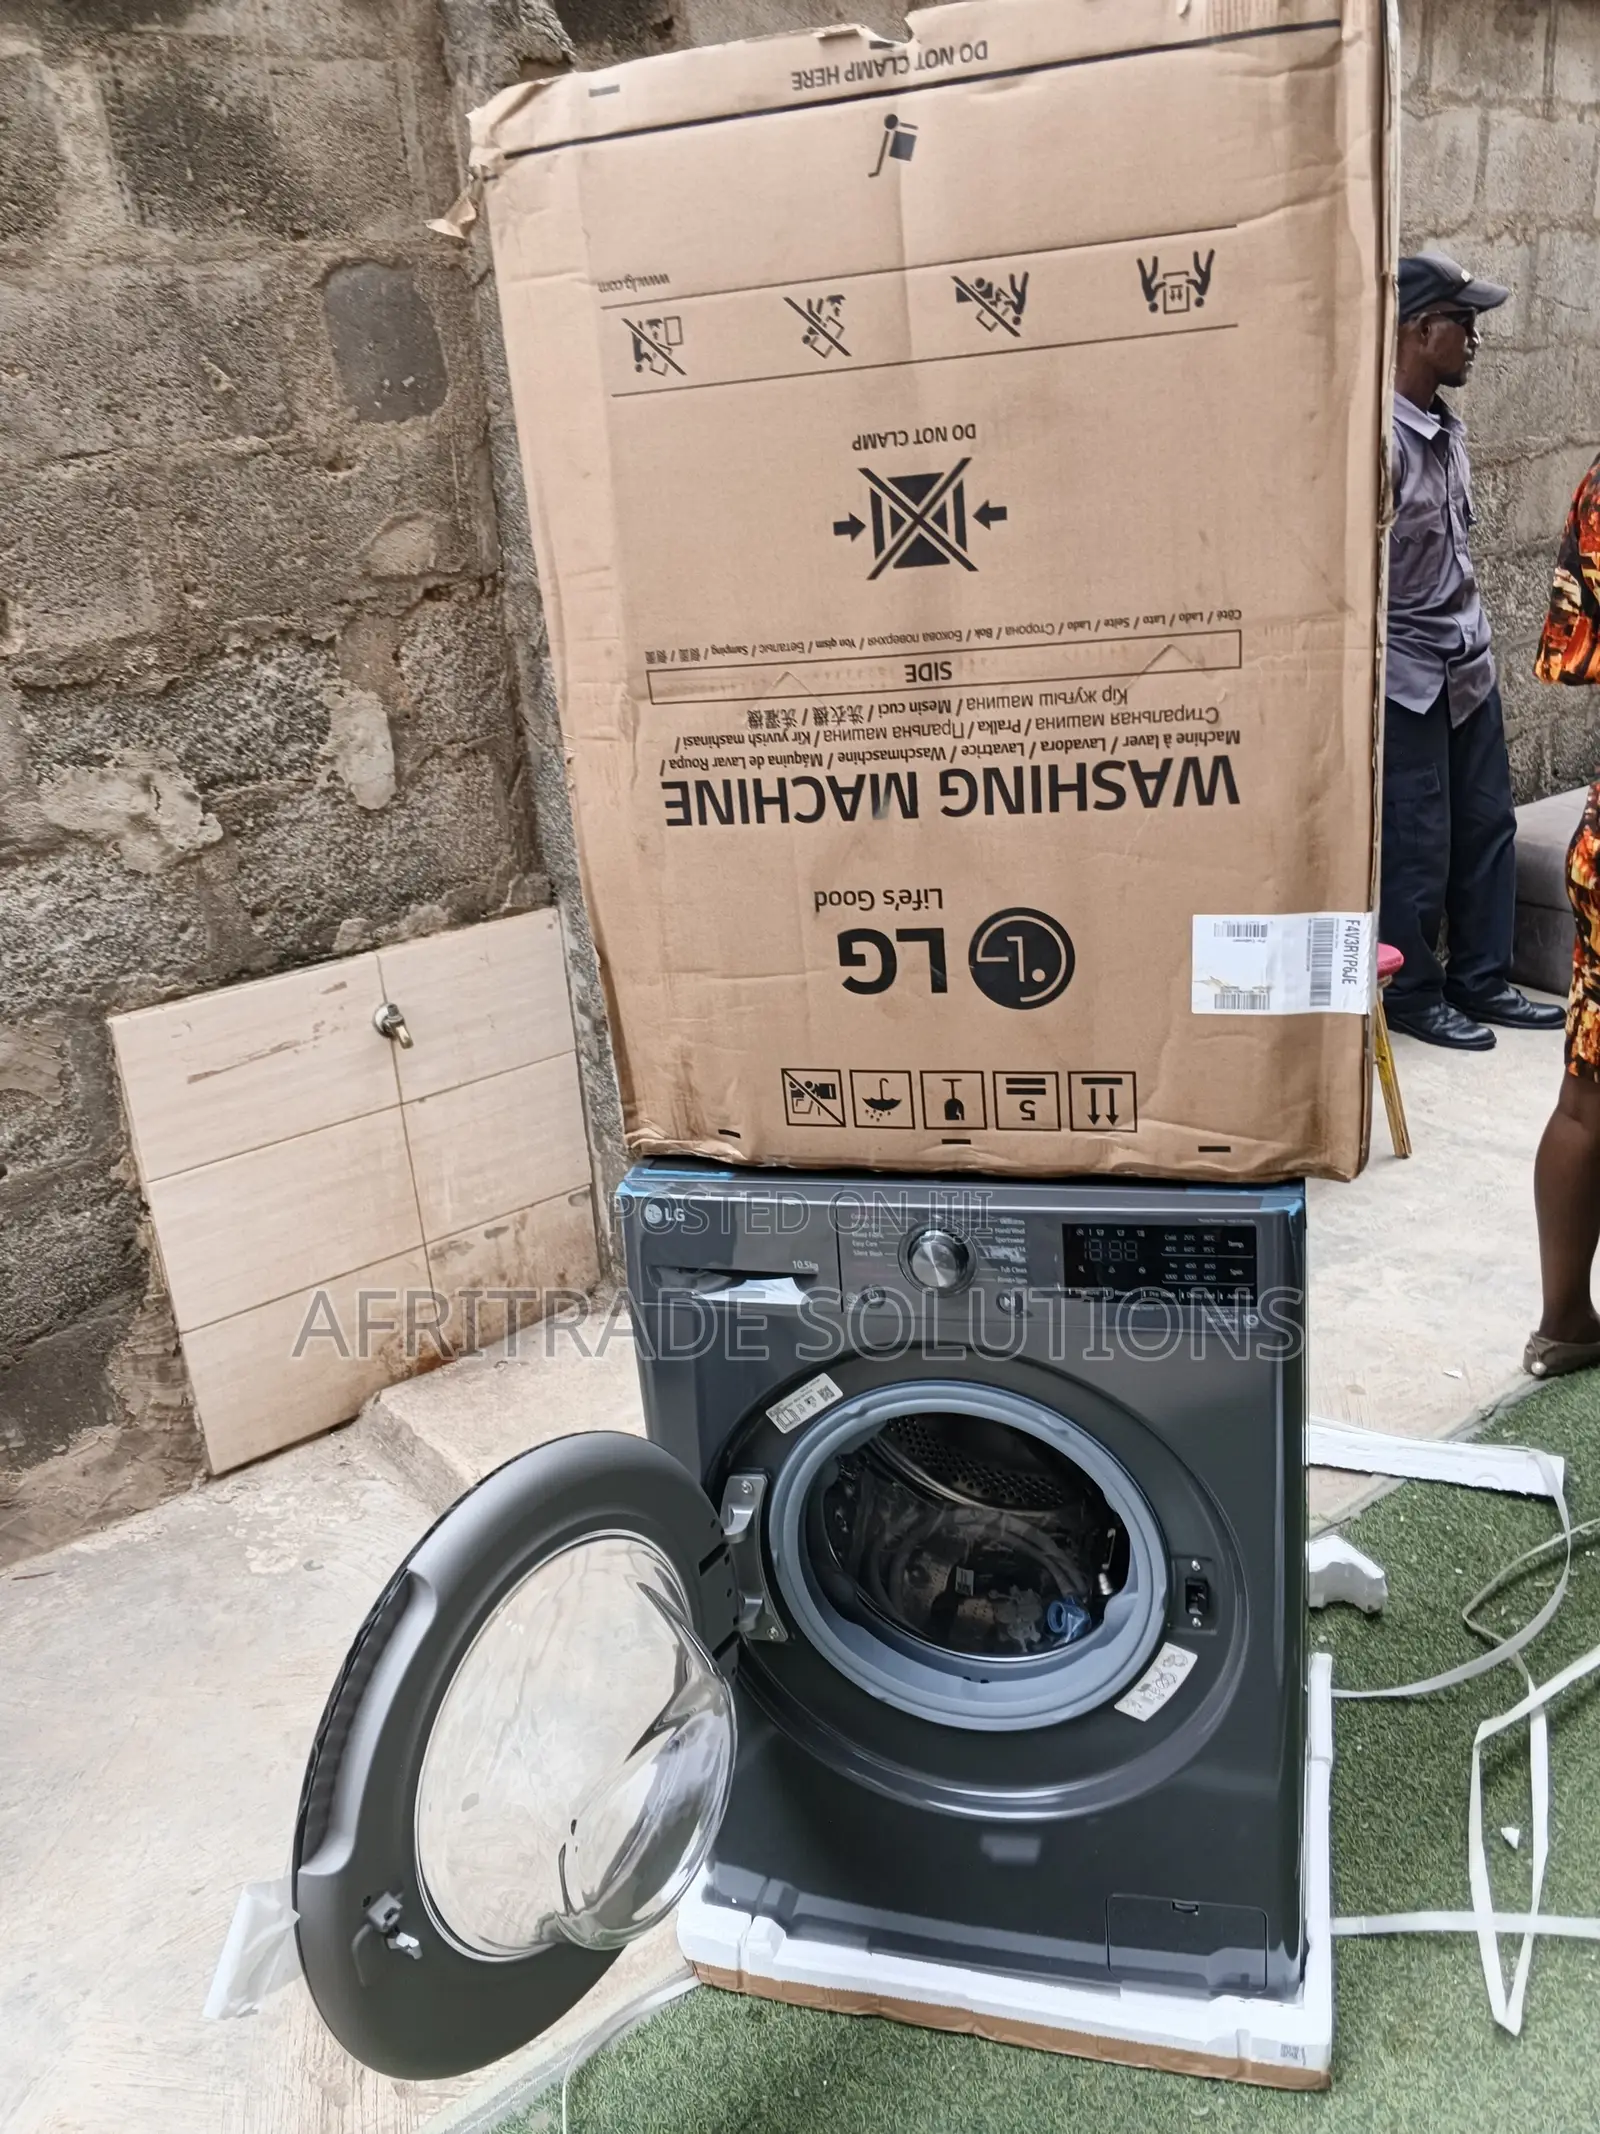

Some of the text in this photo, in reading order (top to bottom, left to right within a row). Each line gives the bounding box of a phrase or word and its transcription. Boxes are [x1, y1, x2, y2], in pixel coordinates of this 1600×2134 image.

[791, 40, 988, 91] DO NOT CLAMP HERE
[597, 273, 670, 293] www.lg.com
[852, 423, 977, 451] DO NOT CLAMP
[1104, 617, 1130, 629] Seite
[1143, 615, 1166, 625] Lato
[1179, 612, 1203, 624] Lado
[1217, 609, 1242, 621] Côté
[974, 628, 992, 639] Bok
[1005, 623, 1055, 636] Сторона
[1067, 620, 1091, 632] Lado
[710, 644, 748, 656] Samping
[904, 661, 952, 683] SIDE
[878, 703, 906, 718] cuci
[910, 700, 951, 715] Mesin
[966, 695, 1033, 711] машина
[1036, 714, 1104, 730] машина
[1110, 707, 1219, 725] Стиральная
[824, 727, 887, 742] машина
[892, 719, 964, 739] Пральна
[977, 719, 1021, 735] Pralka
[683, 734, 745, 750] mashinasi
[748, 731, 790, 748] yuvish
[1040, 738, 1106, 754] Lavadora
[1122, 735, 1159, 749] laver
[1163, 734, 1172, 749] à
[1176, 730, 1240, 747] Machine
[838, 747, 946, 765] Waschmaschine
[961, 743, 1024, 758] Lavatrice
[669, 755, 709, 771] Roupa
[712, 757, 746, 769] Lavar
[749, 756, 764, 769] de
[768, 751, 823, 768] Máquina
[661, 755, 1240, 826] WASHING MACHINE
[814, 888, 943, 913] Life's Good
[1341, 919, 1361, 985] F4V3RYP6JE
[837, 927, 948, 995] LG
[1019, 1099, 1036, 1121] 5
[664, 1207, 685, 1222] LG
[792, 1259, 819, 1273] 10.5kg
